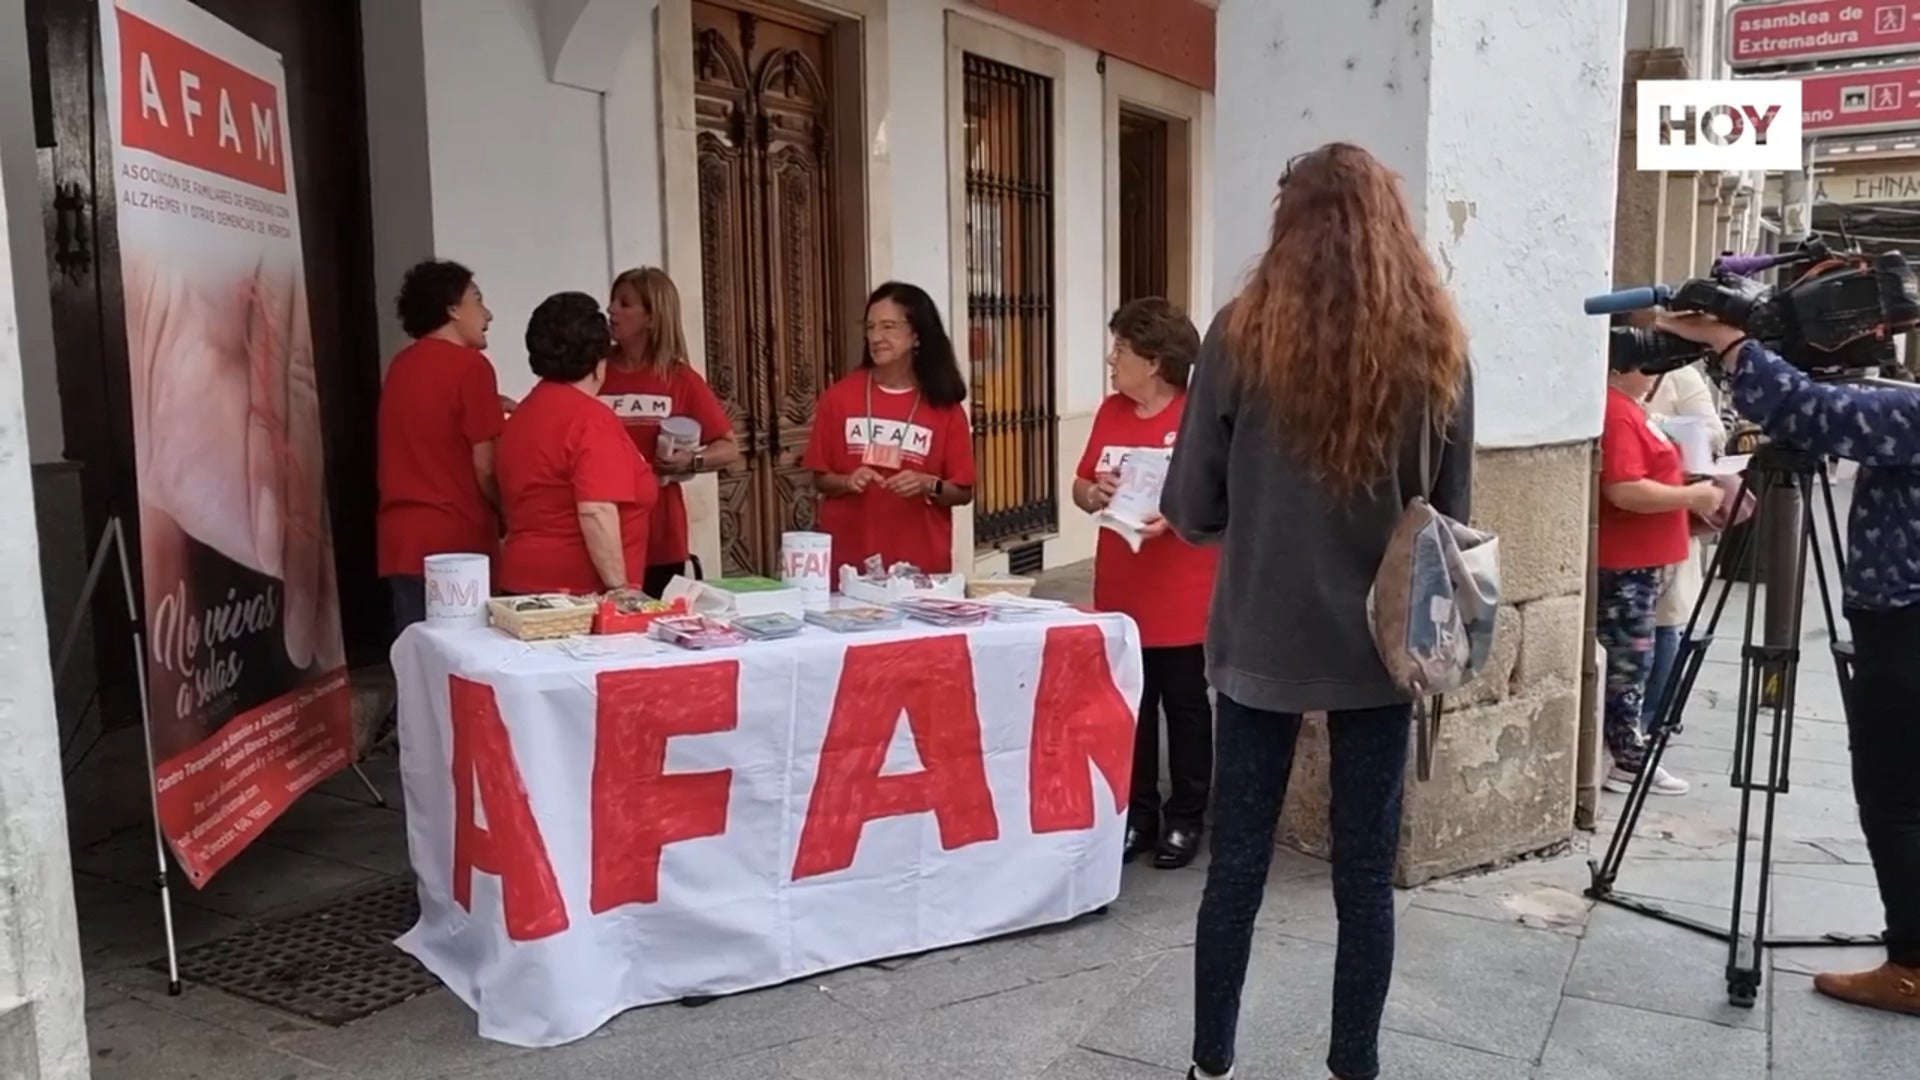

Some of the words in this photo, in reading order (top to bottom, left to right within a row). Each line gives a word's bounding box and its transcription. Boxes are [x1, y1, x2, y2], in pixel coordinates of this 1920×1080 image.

[1740, 11, 1830, 32] asamblea
[1839, 6, 1864, 22] de
[1738, 30, 1859, 54] Extremadura
[140, 51, 275, 166] AFAM
[850, 424, 928, 449] AFAM
[153, 579, 200, 678] No
[204, 584, 279, 648] vivas
[176, 682, 194, 720] a
